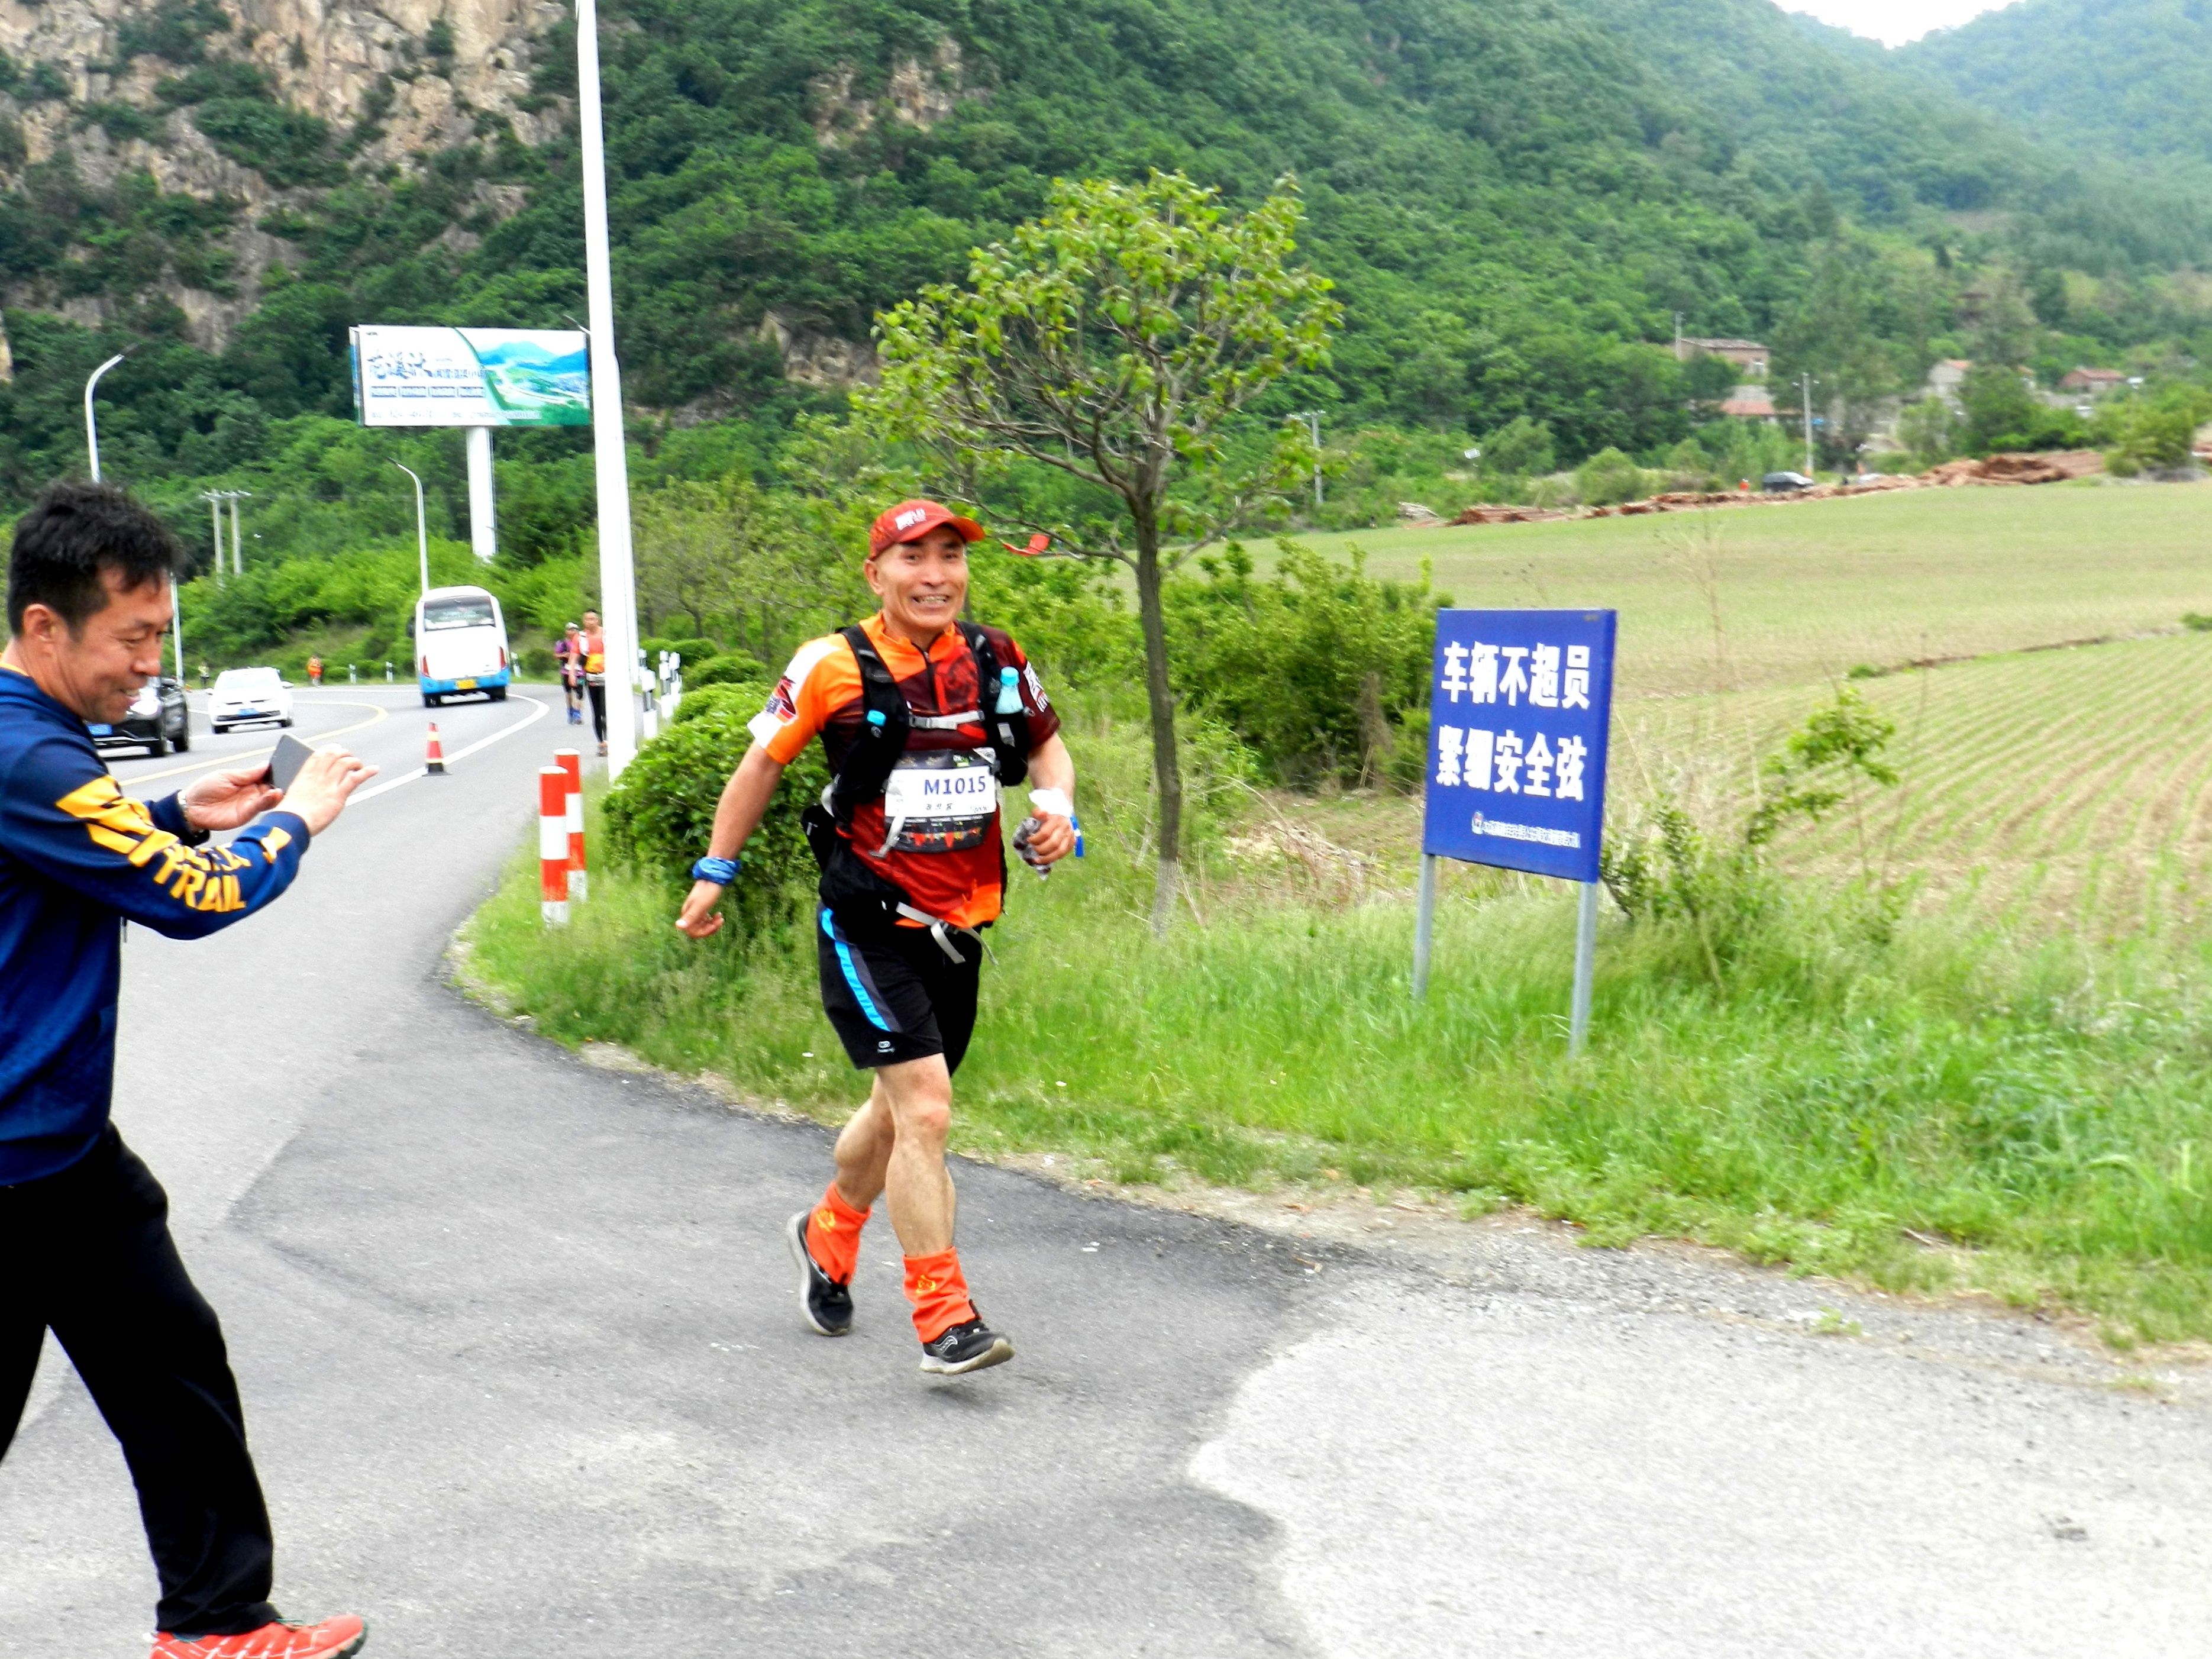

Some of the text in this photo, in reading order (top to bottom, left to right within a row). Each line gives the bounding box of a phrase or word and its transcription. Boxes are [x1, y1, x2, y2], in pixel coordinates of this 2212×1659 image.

[1441, 641, 1590, 709] 车辆不超员
[924, 776, 986, 795] M1015
[153, 848, 246, 912] TRAIL
